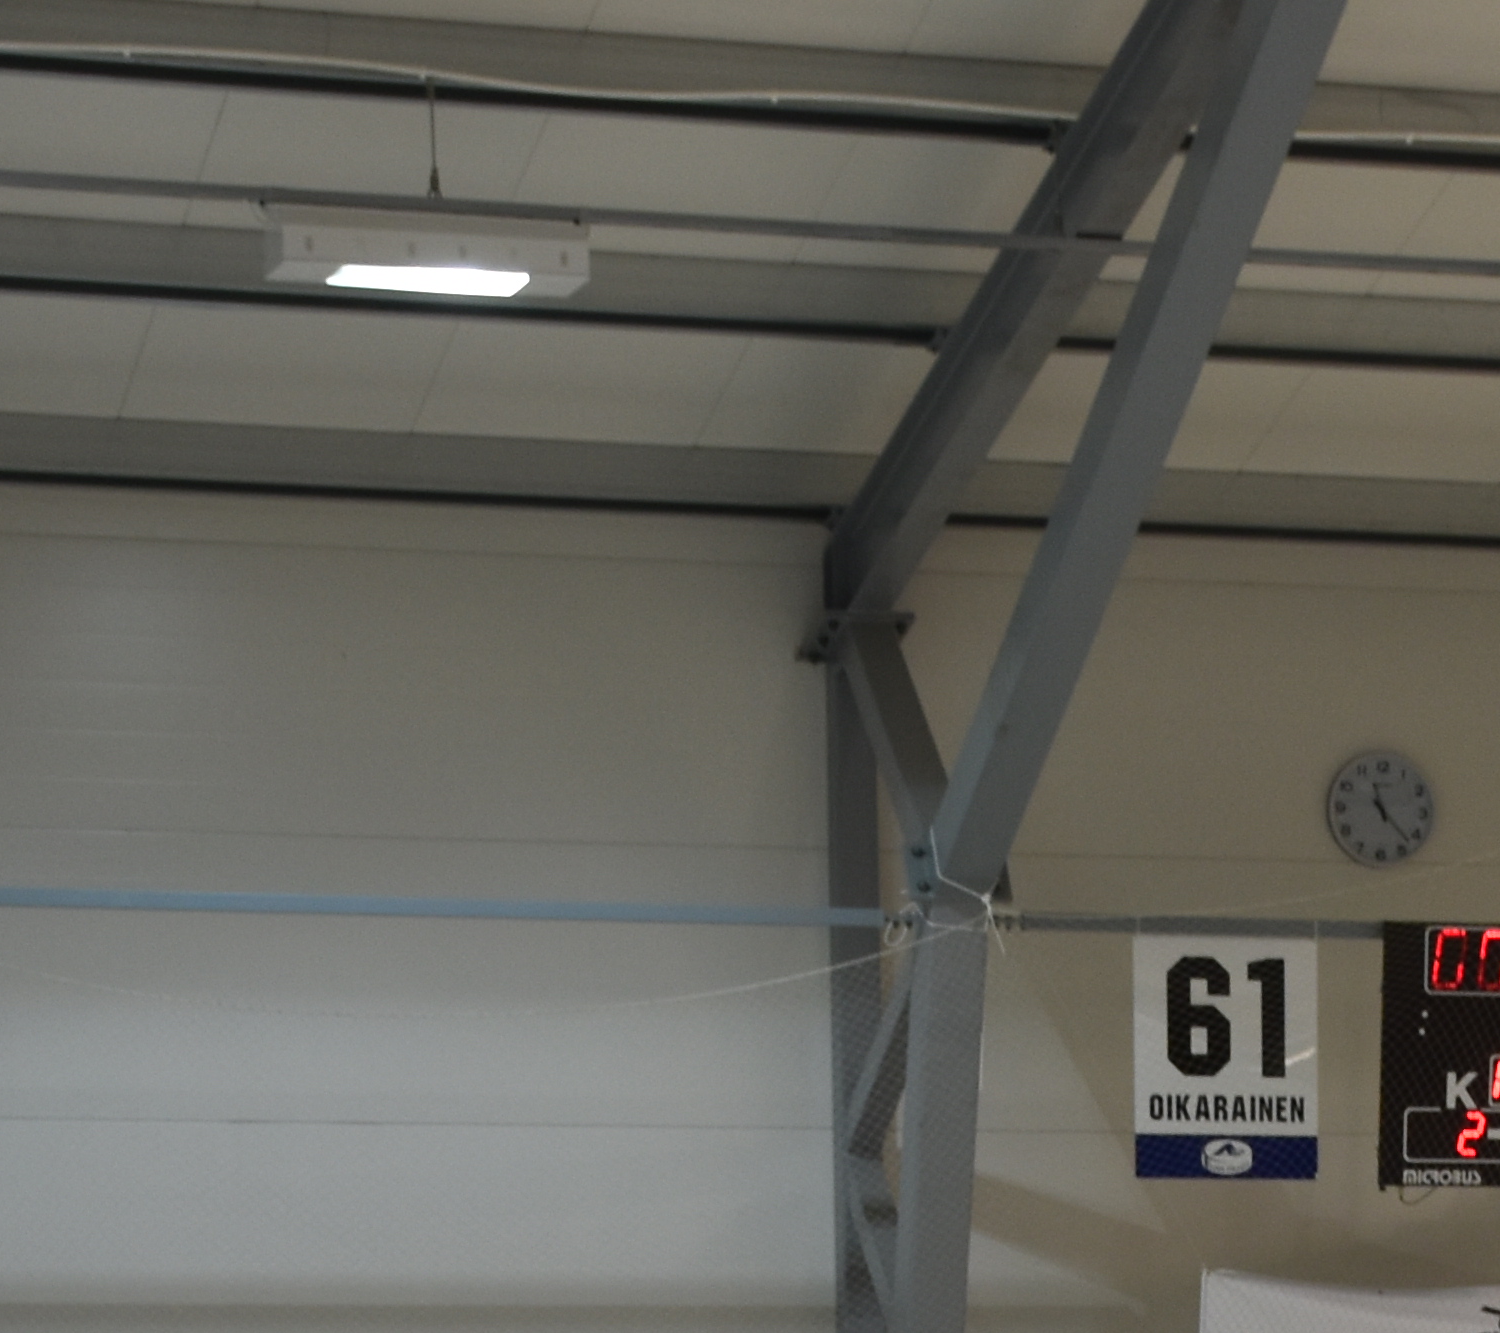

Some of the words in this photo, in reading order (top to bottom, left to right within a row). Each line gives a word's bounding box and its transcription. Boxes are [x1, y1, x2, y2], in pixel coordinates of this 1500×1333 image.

[1166, 956, 1286, 1079] 61
[1149, 1094, 1306, 1123] OIKARAINEN
[1445, 1071, 1479, 1111] K
